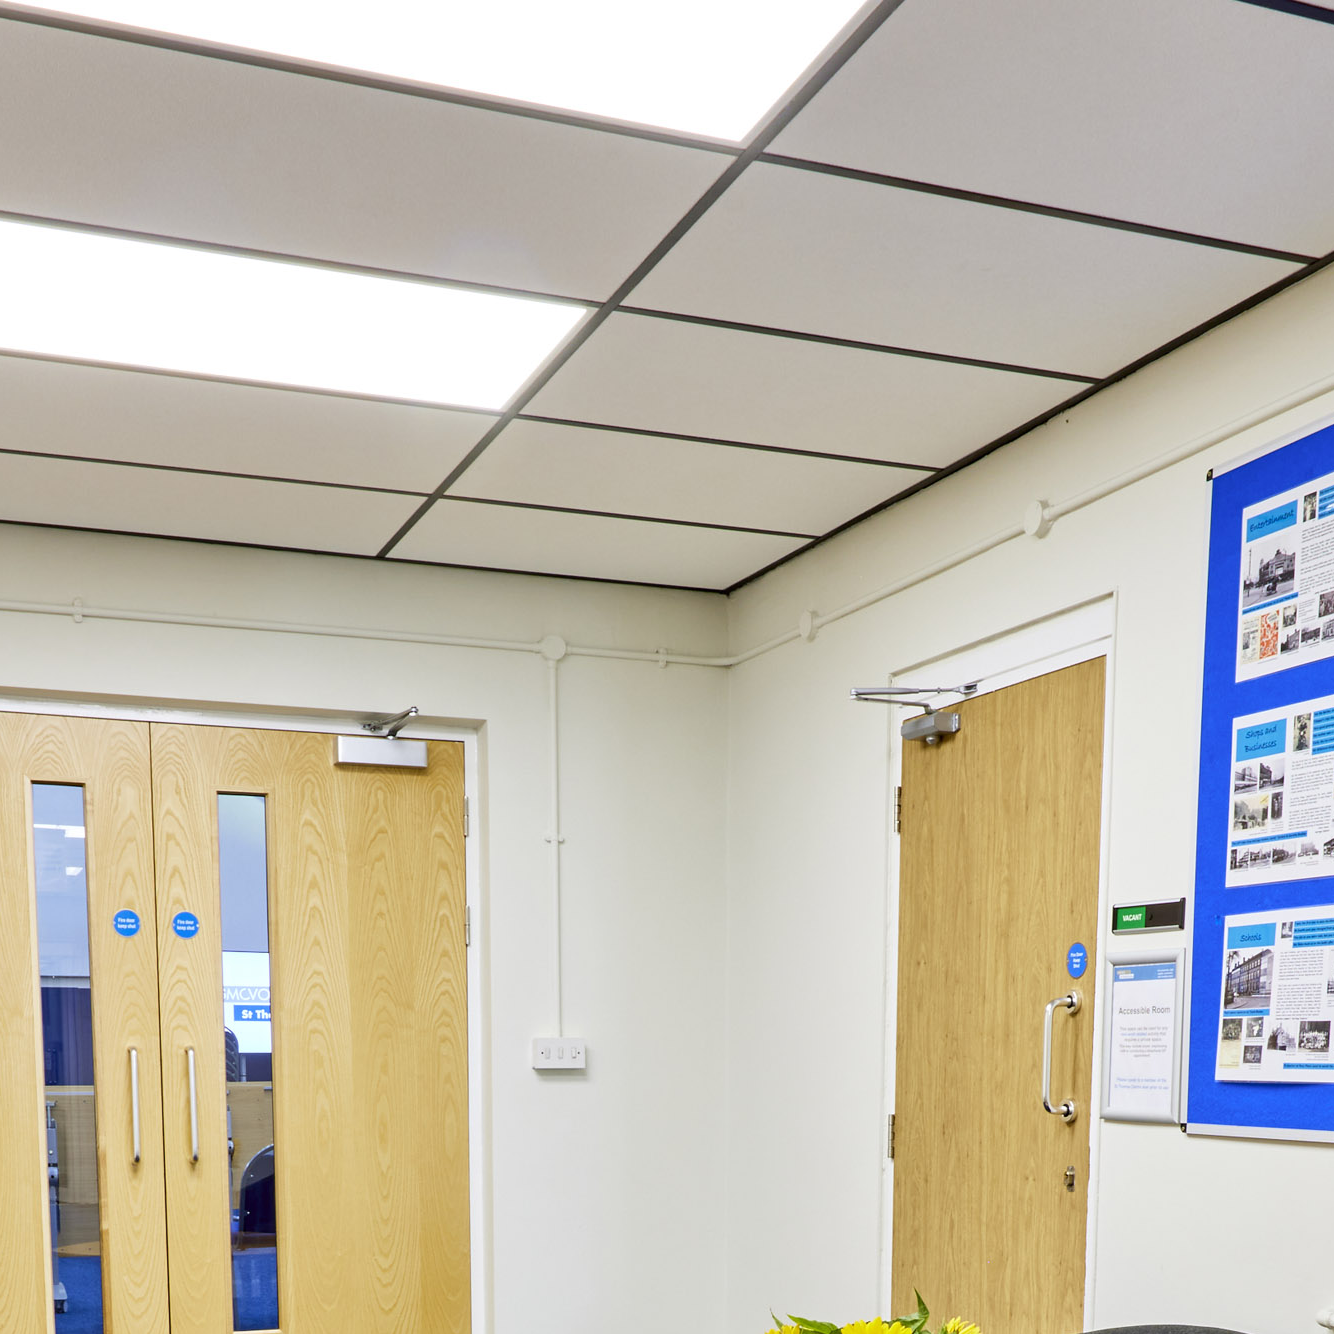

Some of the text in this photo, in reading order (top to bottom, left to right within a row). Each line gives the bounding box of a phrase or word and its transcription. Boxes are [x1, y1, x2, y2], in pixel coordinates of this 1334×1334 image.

[1250, 509, 1294, 532] Entertainment
[1245, 725, 1277, 739] Shops and
[1244, 740, 1277, 752] Businesses
[1122, 913, 1142, 922] VACANT
[1239, 932, 1262, 942] Schools
[241, 1009, 253, 1019] St
[1118, 1006, 1170, 1015] Accessible Room
